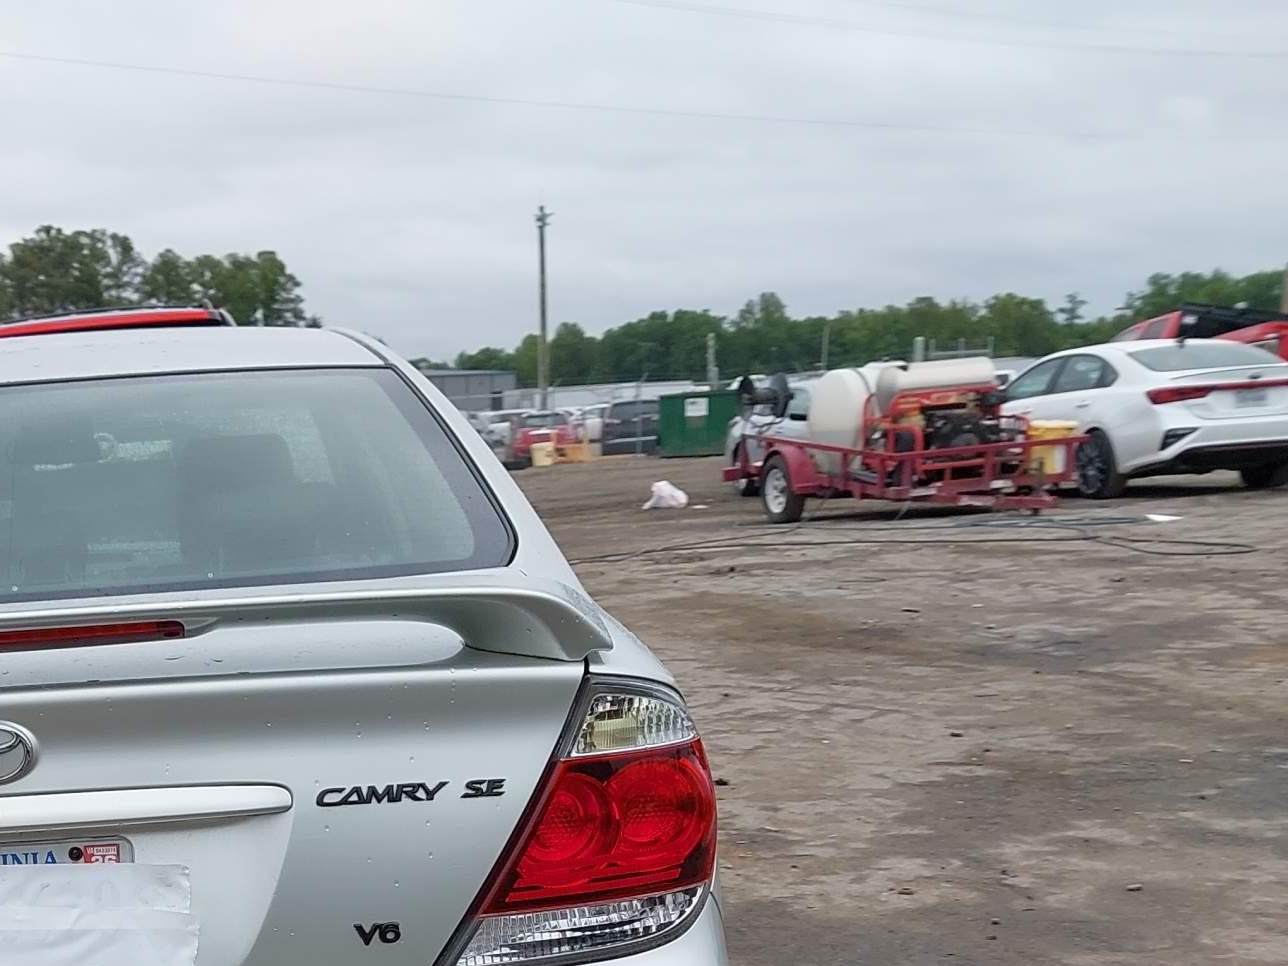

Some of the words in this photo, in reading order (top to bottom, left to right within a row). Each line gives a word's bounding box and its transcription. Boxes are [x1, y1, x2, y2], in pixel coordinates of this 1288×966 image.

[316, 780, 450, 807] CAMRY
[461, 778, 506, 799] SE
[353, 922, 401, 946] V6
